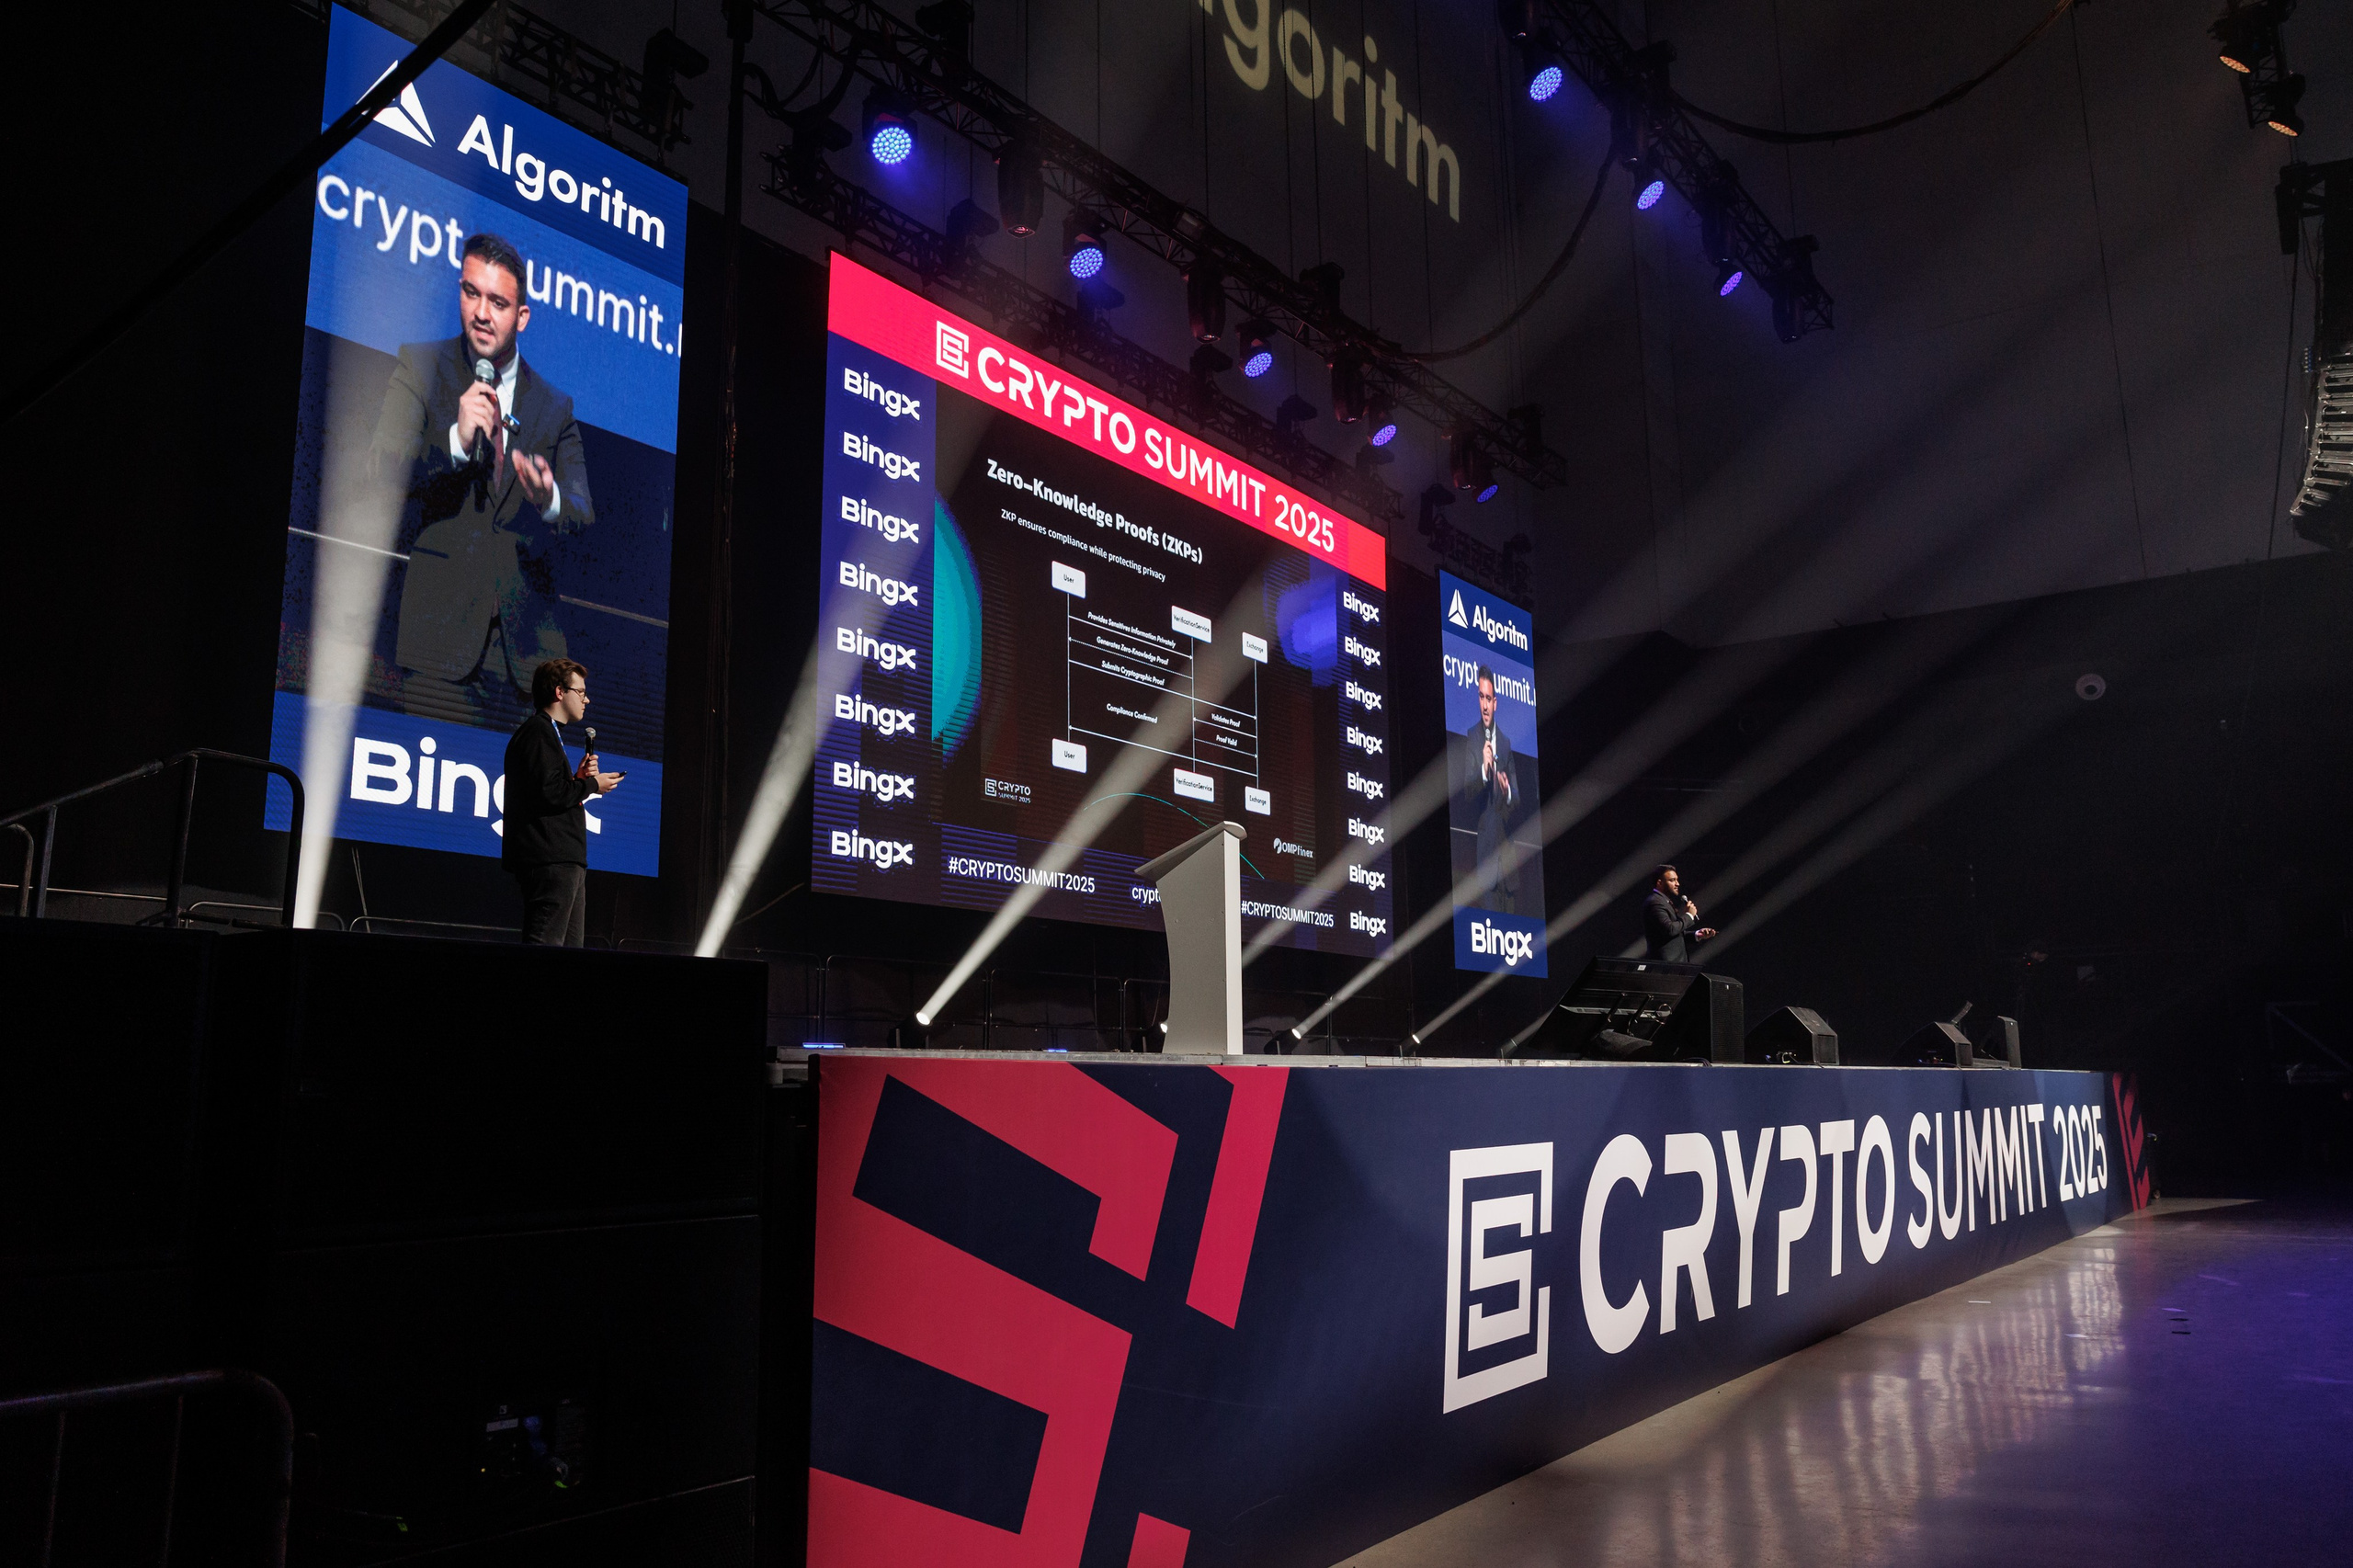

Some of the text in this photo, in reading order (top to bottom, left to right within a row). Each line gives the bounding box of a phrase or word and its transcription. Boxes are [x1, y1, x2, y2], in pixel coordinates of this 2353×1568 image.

[458, 114, 665, 250] Algoritm
[977, 347, 1335, 553] CRYPTO SUMMIT 2025
[1001, 508, 1166, 583] ZKP ensures compliance while protecting privacy
[1115, 513, 1160, 547] Proofs
[1162, 532, 1203, 565] (ZKPs)
[1063, 574, 1074, 584] User
[1087, 611, 1108, 625] Provides
[1131, 626, 1157, 642] Information
[1472, 605, 1528, 652] Algoritm
[1120, 643, 1156, 663] Zero-Knowledge
[1156, 655, 1169, 665] Proof
[1102, 660, 1165, 686] Submits Cryptographic Proof
[1106, 703, 1158, 724] Compliance Confirmed
[1211, 712, 1241, 728] Validates Proof
[1215, 734, 1238, 747] Proof Valid
[1063, 750, 1075, 759] User
[998, 780, 1031, 796] CRYPTO
[1175, 777, 1212, 792] VerificationService
[1249, 794, 1267, 805] Exchange
[948, 857, 1096, 893] #CRYPTOSUMMIT2025
[1131, 887, 1162, 904] crypt
[1241, 900, 1335, 927] #CRYPTOSUMMIT2025
[1580, 1104, 2108, 1354] CRYPTO SUMMIT 2025
